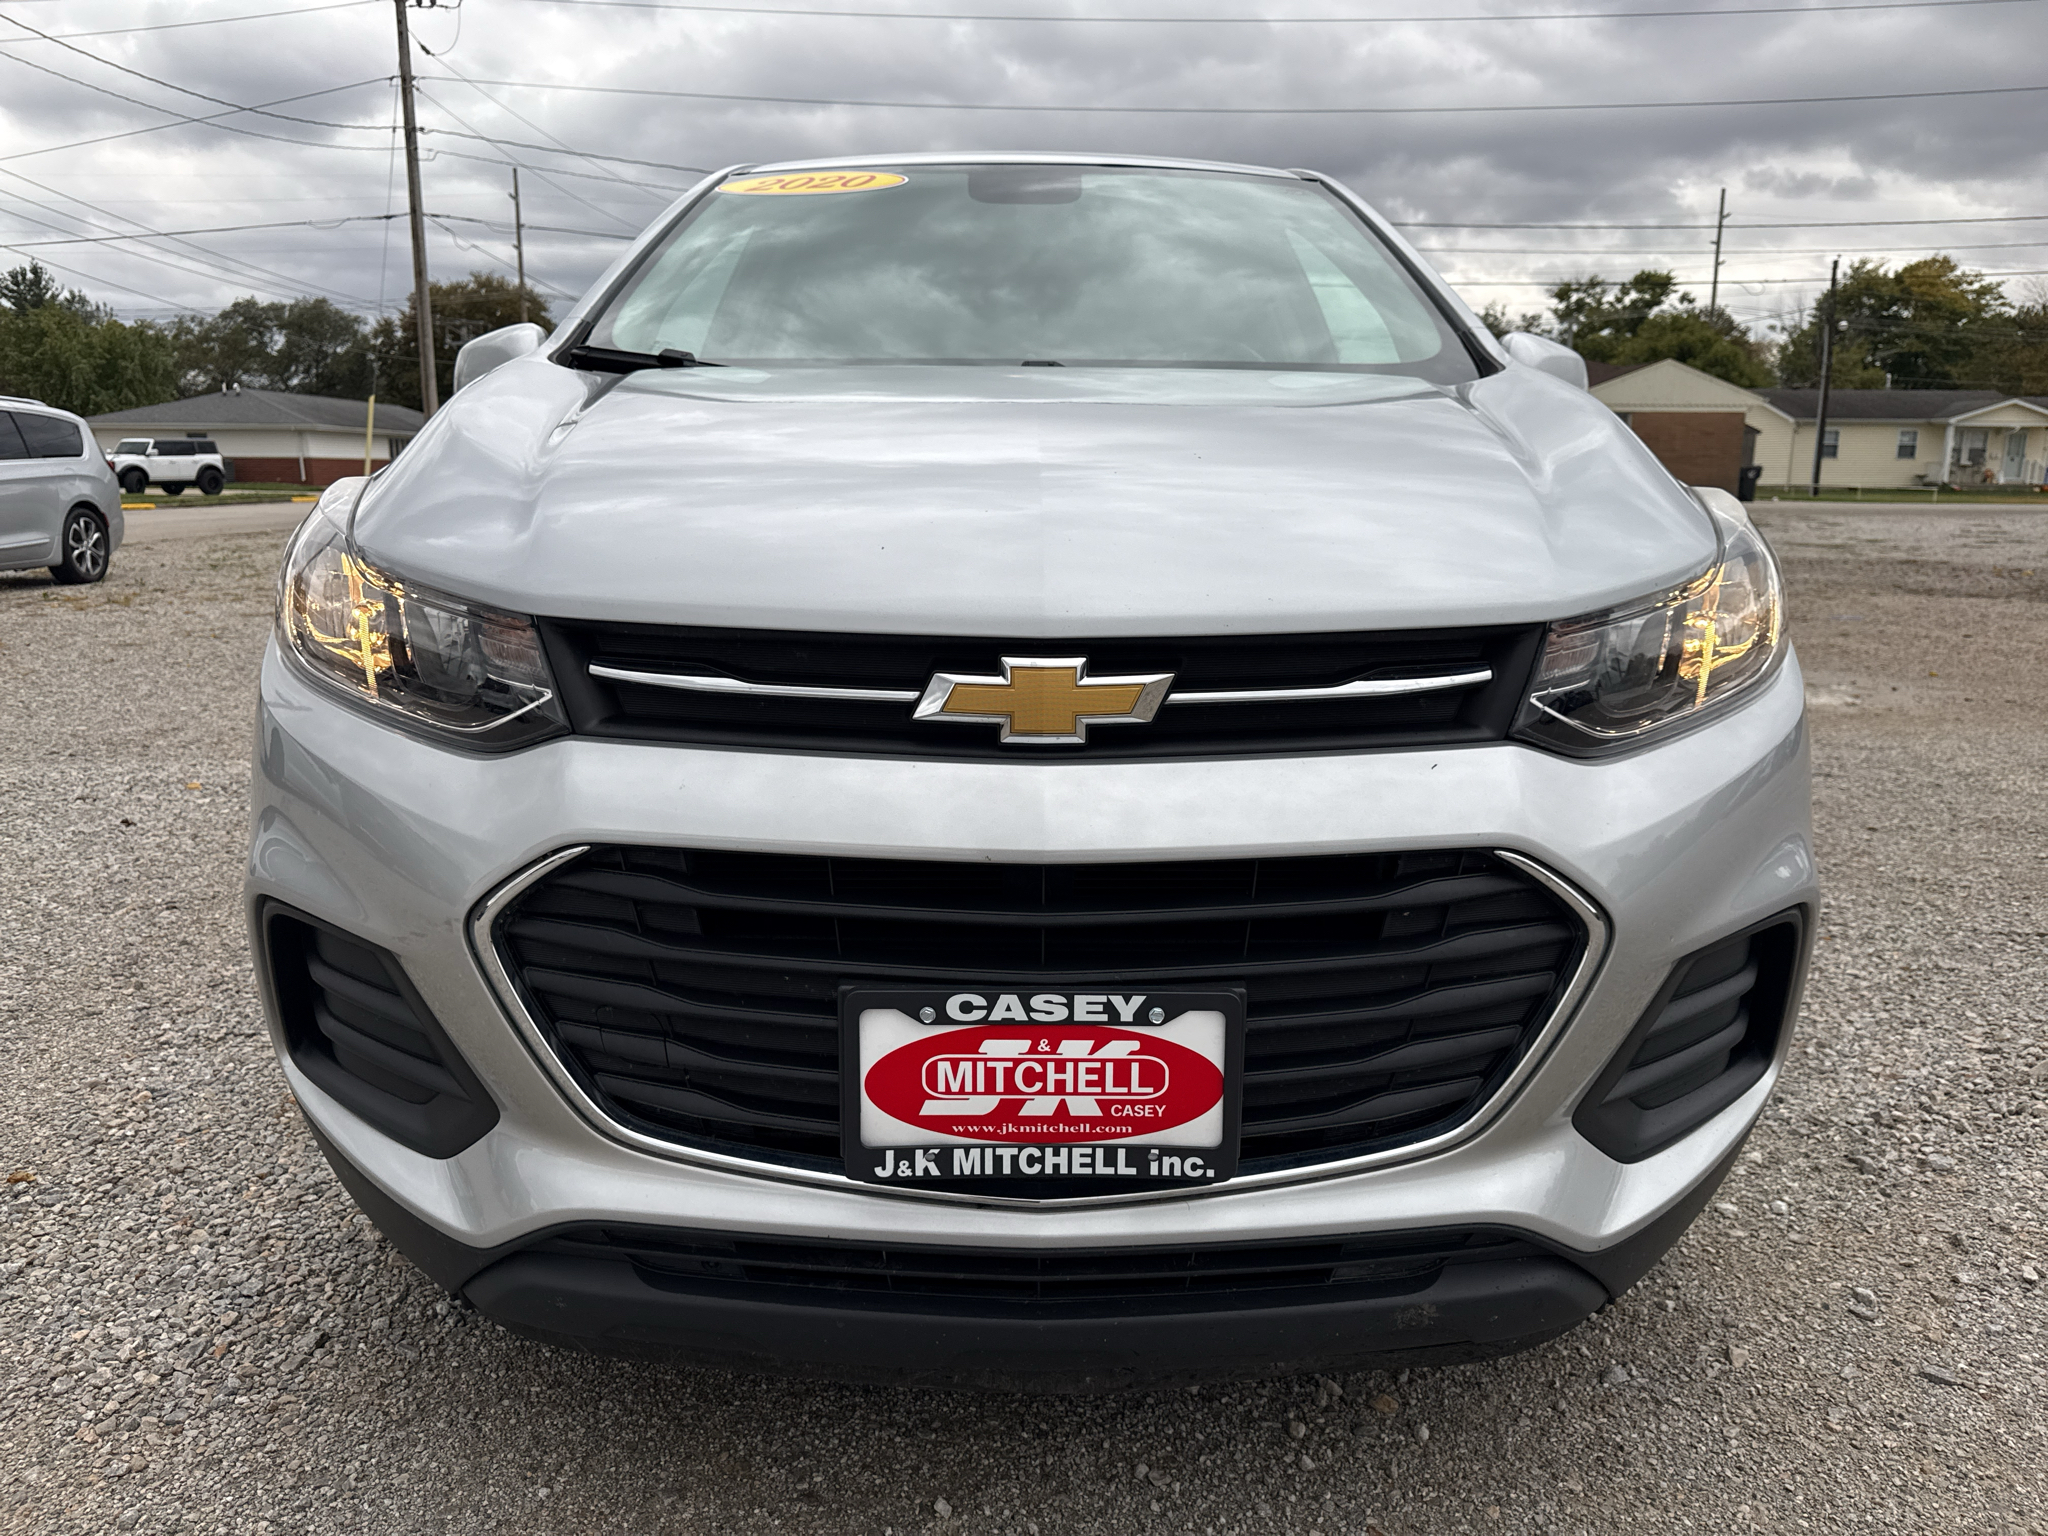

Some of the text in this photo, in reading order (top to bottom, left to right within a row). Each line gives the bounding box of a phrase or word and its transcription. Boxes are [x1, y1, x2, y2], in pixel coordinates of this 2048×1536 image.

[744, 175, 877, 192] 2020
[945, 993, 1146, 1022] CASEY
[936, 1061, 1154, 1093] MITCHELL
[1110, 1104, 1167, 1117] CASEY
[952, 1123, 1133, 1135] www.jkmitchell.com
[874, 1148, 1215, 1178] J&K MITCHELL inc.
